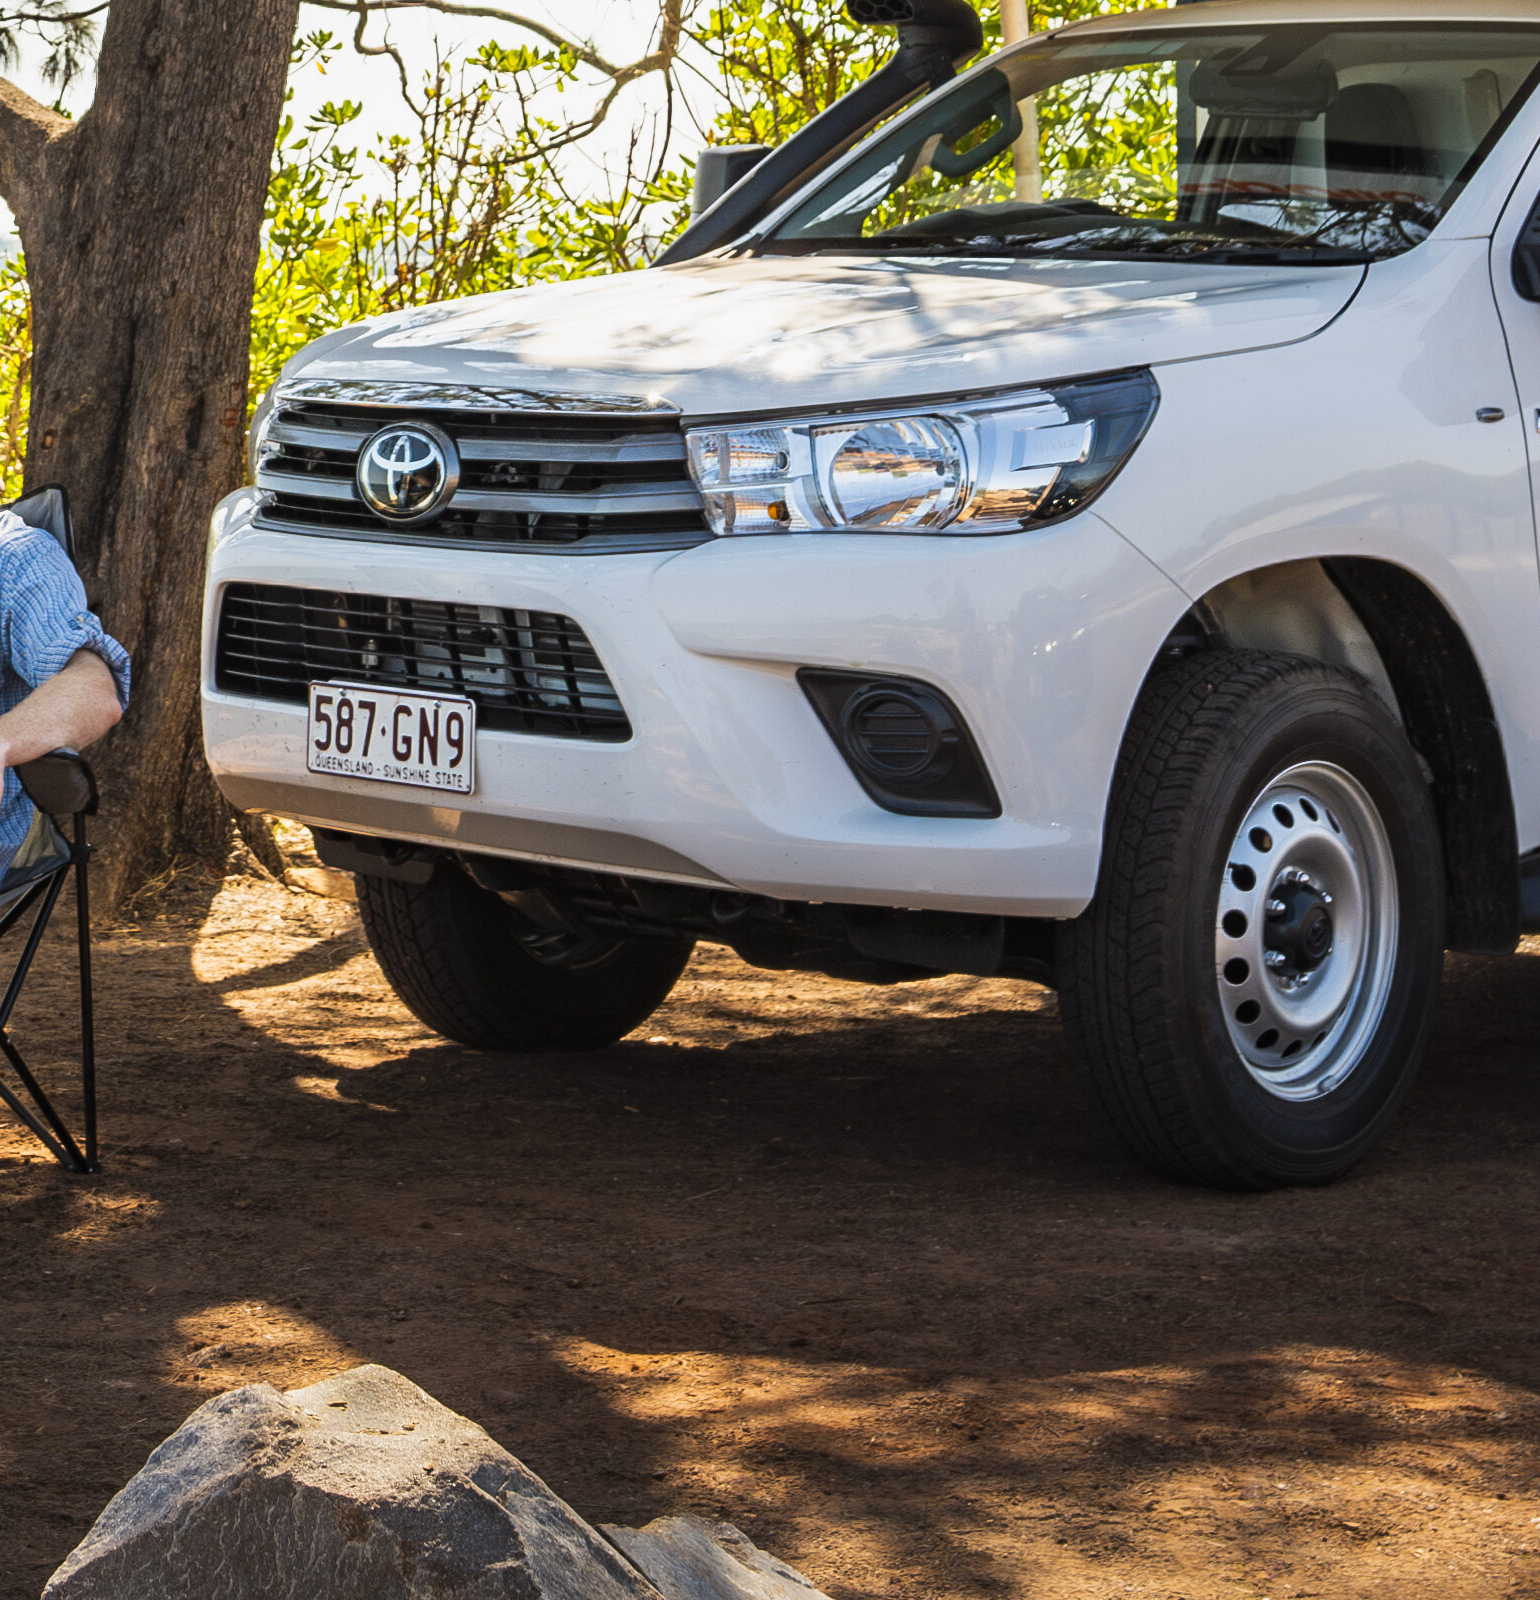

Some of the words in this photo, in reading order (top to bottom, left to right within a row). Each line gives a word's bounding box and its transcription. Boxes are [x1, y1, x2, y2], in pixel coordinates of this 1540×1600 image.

[315, 754, 374, 775] QUEENSLAND
[383, 764, 431, 783] SUNSHINE
[435, 773, 463, 788] STATE
